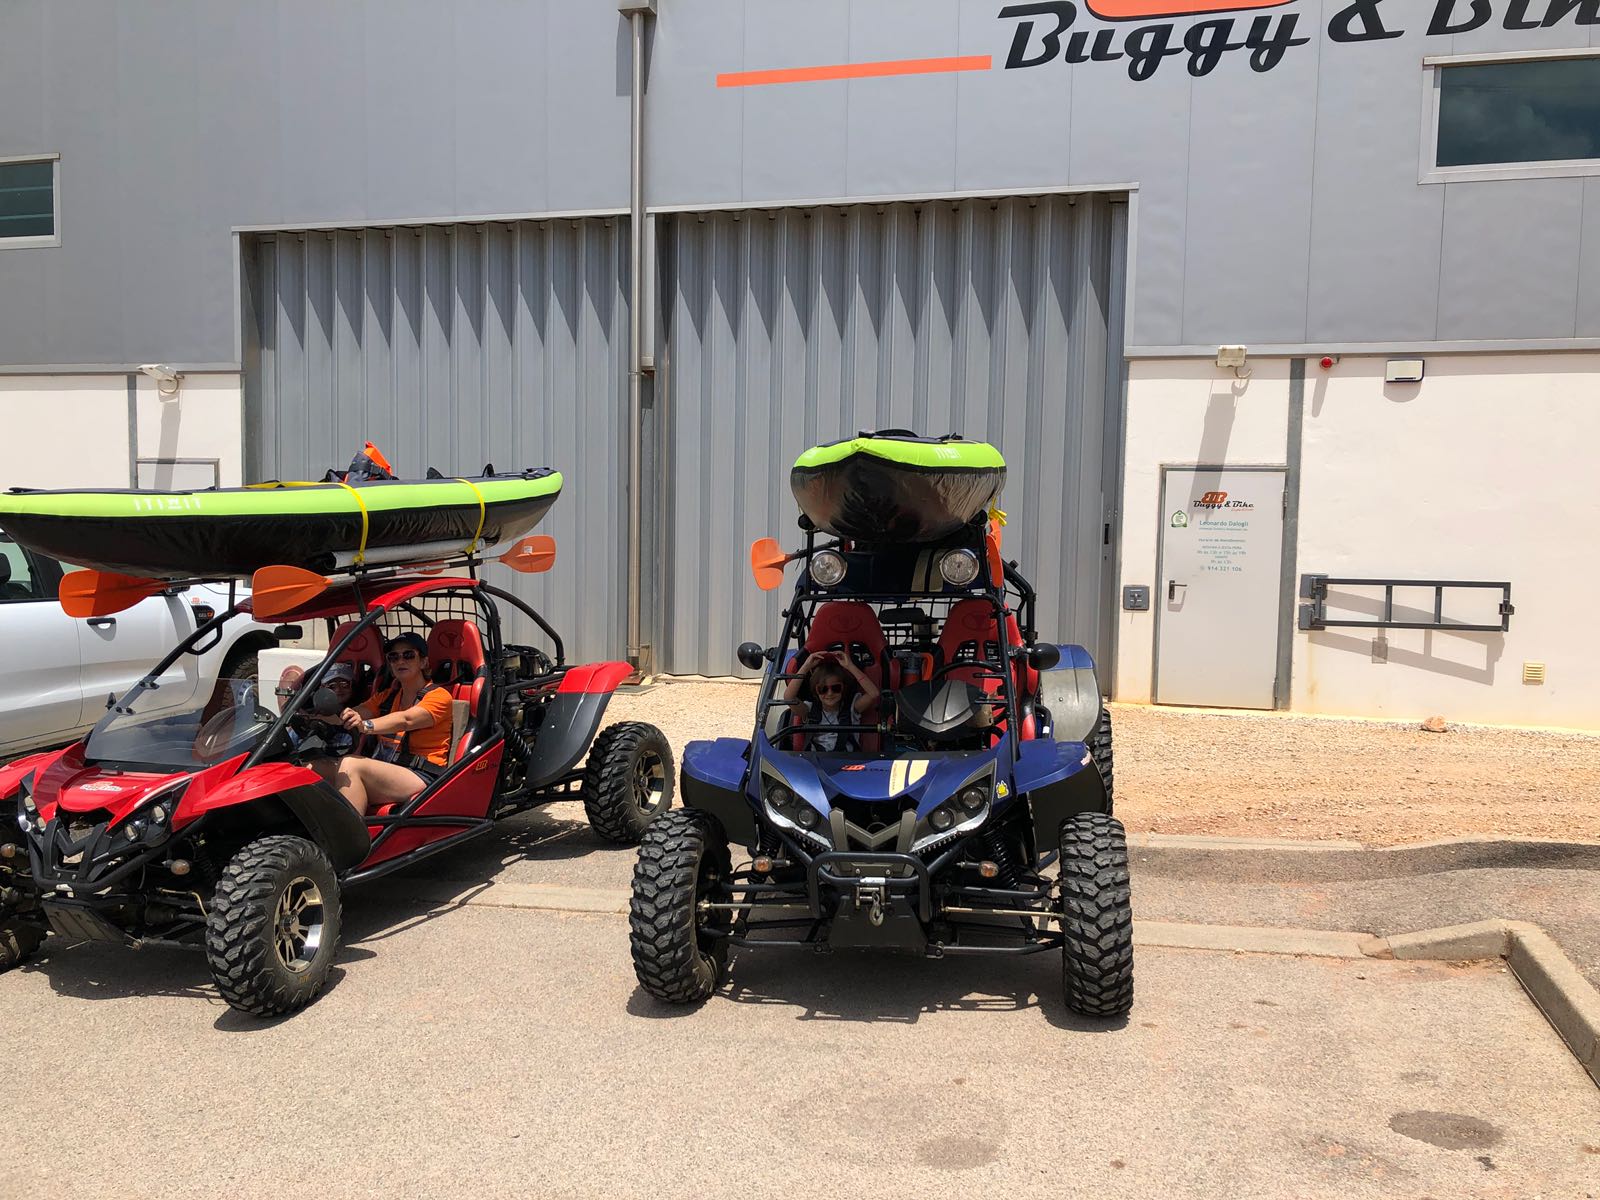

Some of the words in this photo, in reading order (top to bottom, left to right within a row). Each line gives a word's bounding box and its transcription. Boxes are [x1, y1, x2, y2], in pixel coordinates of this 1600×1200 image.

[997, 0, 1310, 81] Buggy
[1193, 500, 1223, 509] Buggy
[1224, 500, 1231, 508] &
